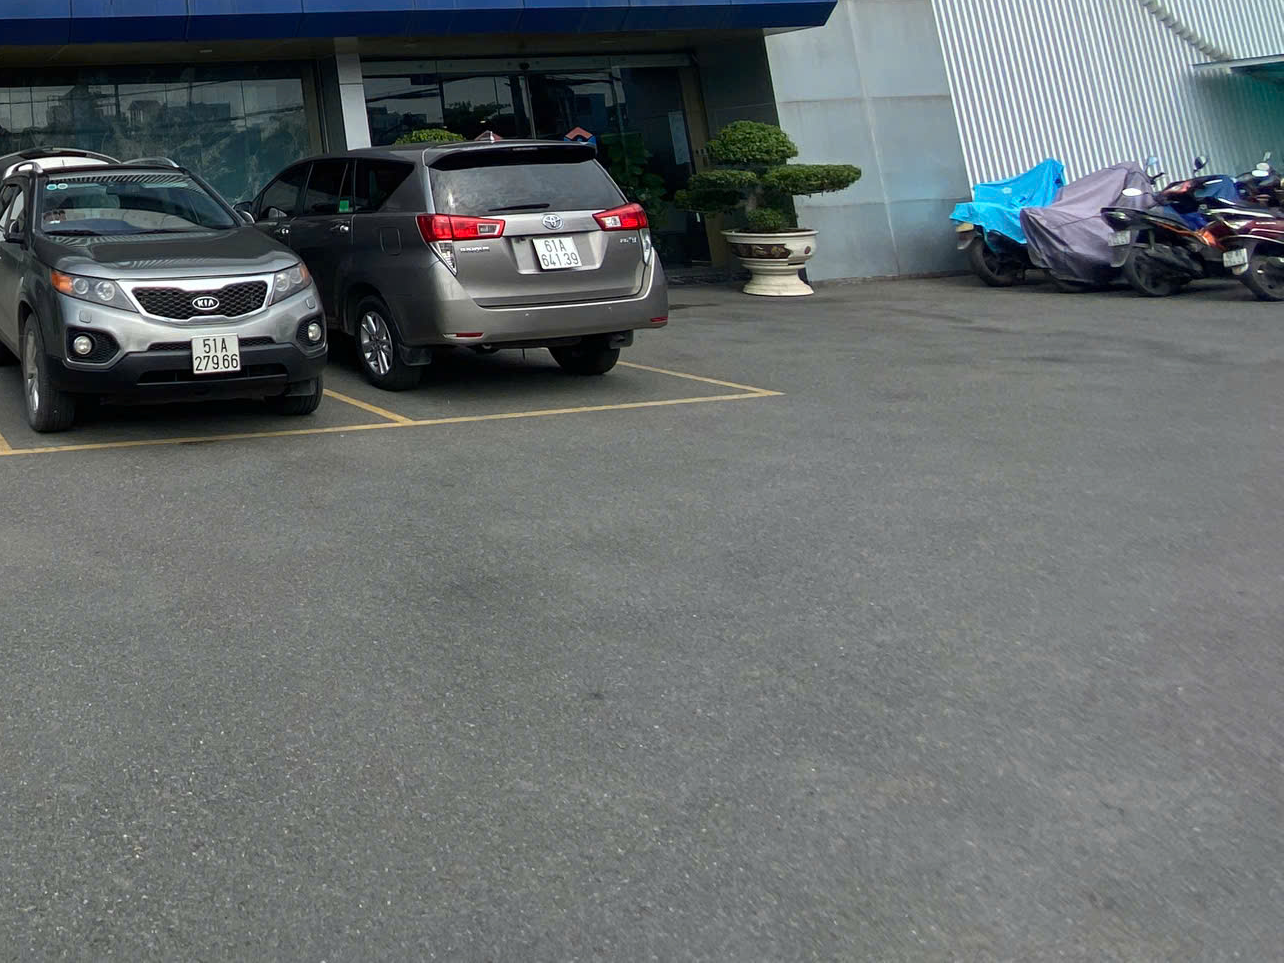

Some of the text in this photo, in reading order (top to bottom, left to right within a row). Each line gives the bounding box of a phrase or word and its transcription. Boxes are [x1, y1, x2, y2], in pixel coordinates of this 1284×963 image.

[544, 240, 567, 253] 61A
[202, 337, 228, 354] 51A
[195, 353, 239, 371] 279.66
